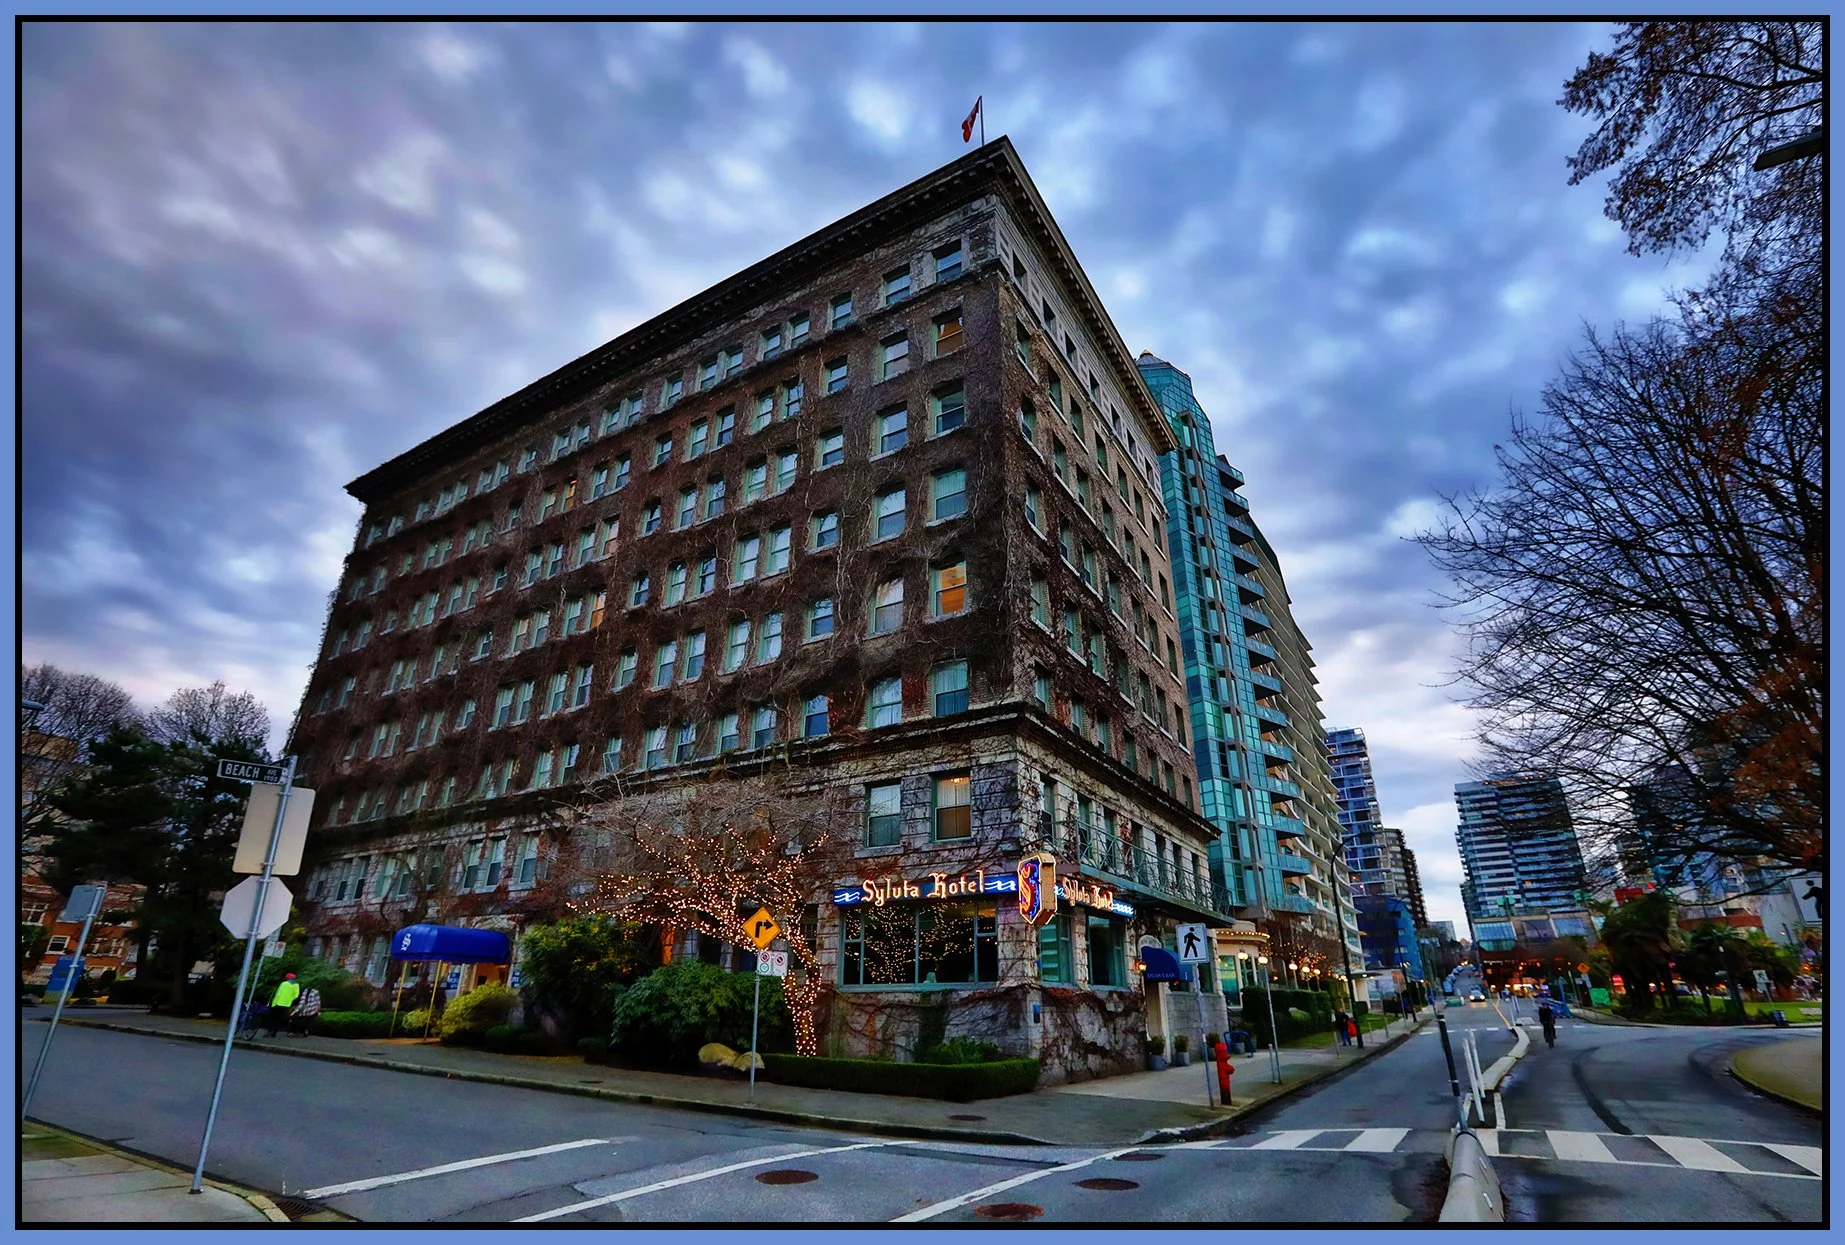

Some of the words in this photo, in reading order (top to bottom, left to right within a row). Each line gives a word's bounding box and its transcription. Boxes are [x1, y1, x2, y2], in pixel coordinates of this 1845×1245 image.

[225, 763, 260, 778] BEACH
[861, 878, 920, 907] Sylvia
[927, 869, 985, 899] Hotel
[1091, 885, 1118, 911] Hotel
